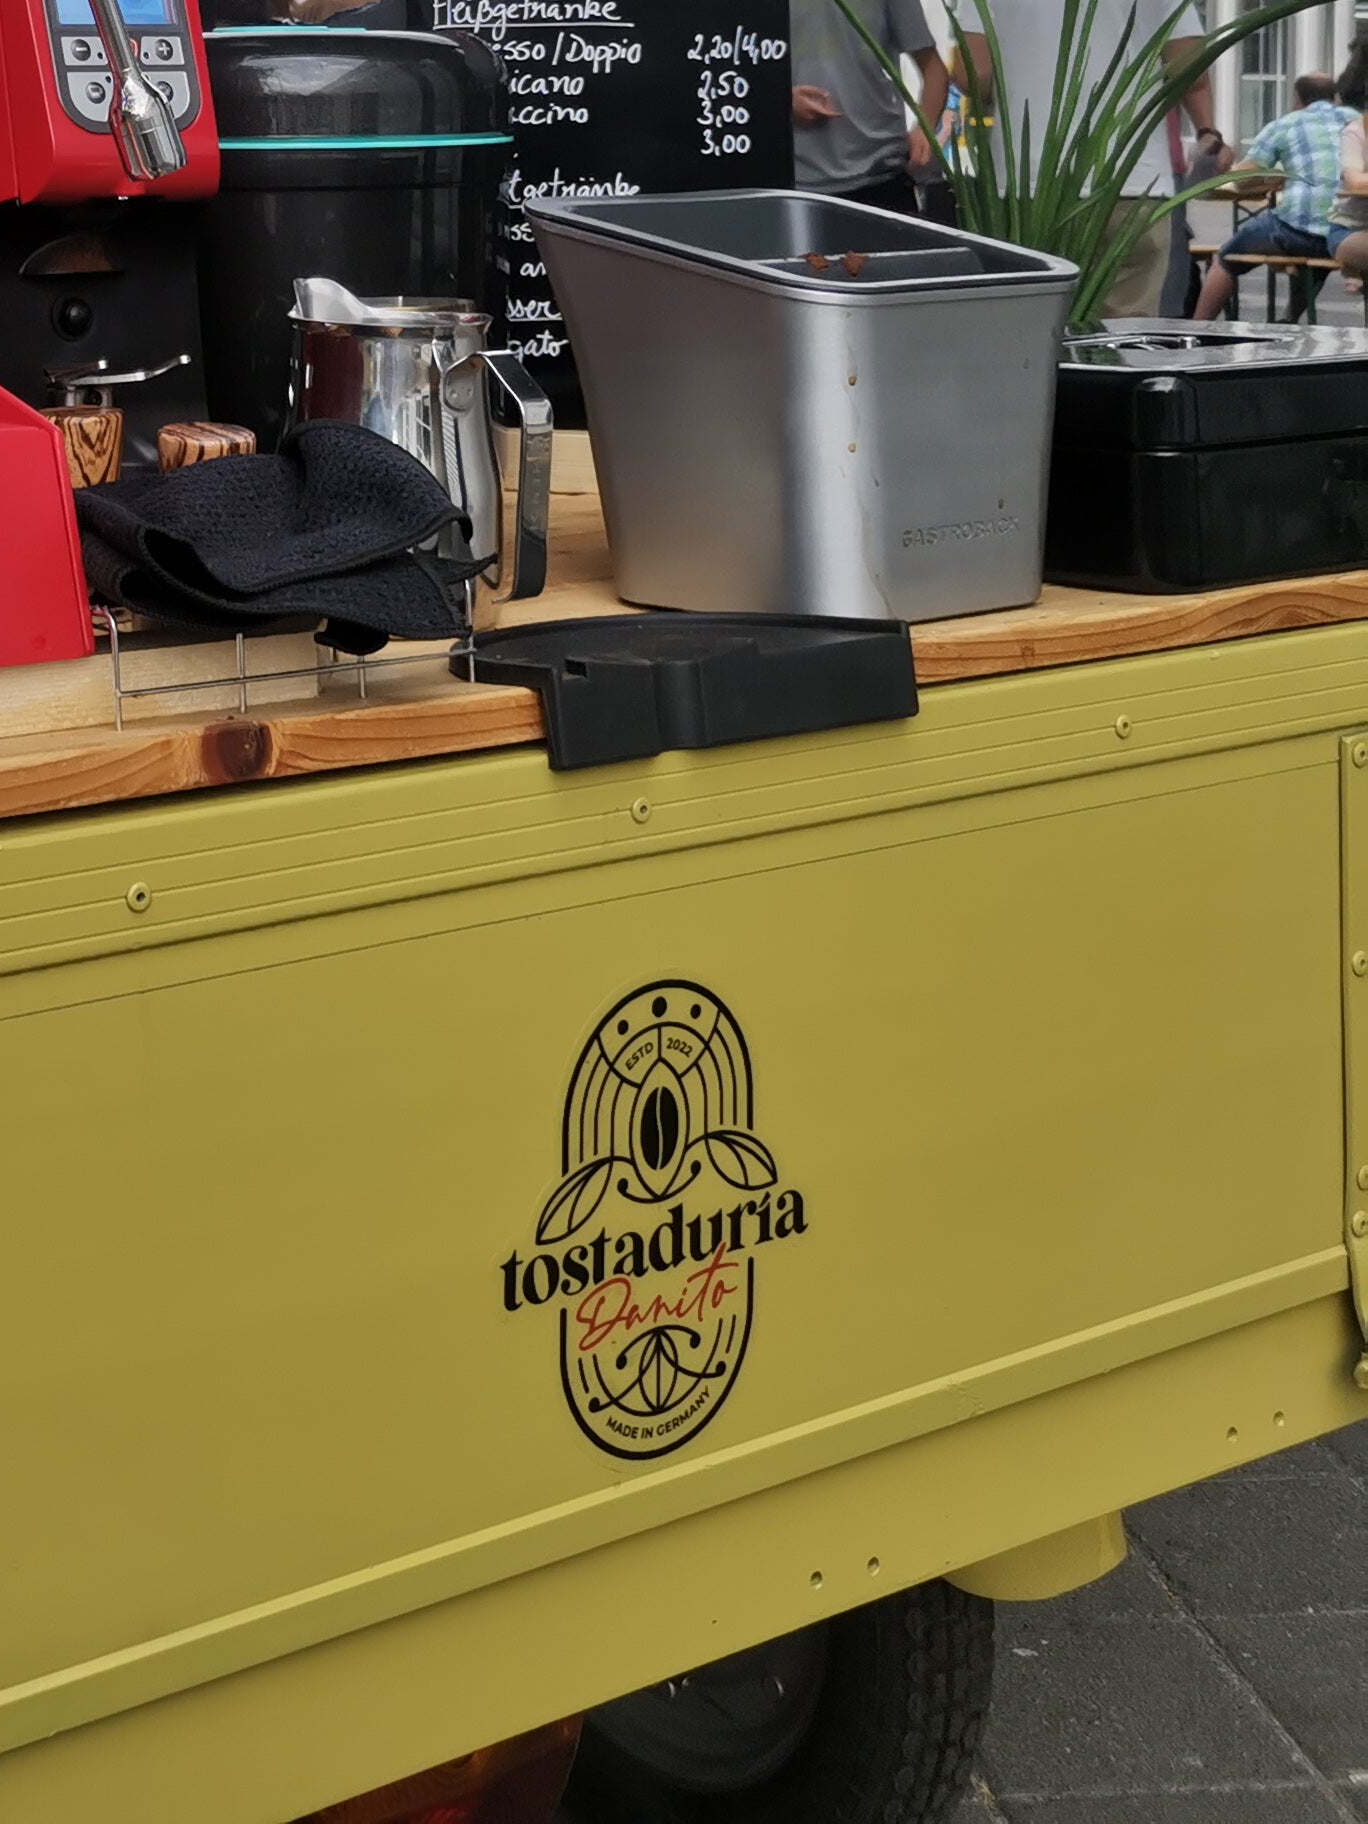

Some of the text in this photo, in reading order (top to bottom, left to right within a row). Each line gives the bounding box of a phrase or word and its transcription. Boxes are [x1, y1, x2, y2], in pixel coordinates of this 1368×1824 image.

[508, 69, 749, 101] icano 2,50
[508, 100, 750, 128] ccino 3,00
[700, 128, 751, 157] 3,00
[624, 1036, 694, 1071] ESTD 2022
[499, 1189, 809, 1312] tostaduría
[576, 1241, 739, 1352] Danito
[605, 1384, 711, 1439] MADE IN GERMANY
